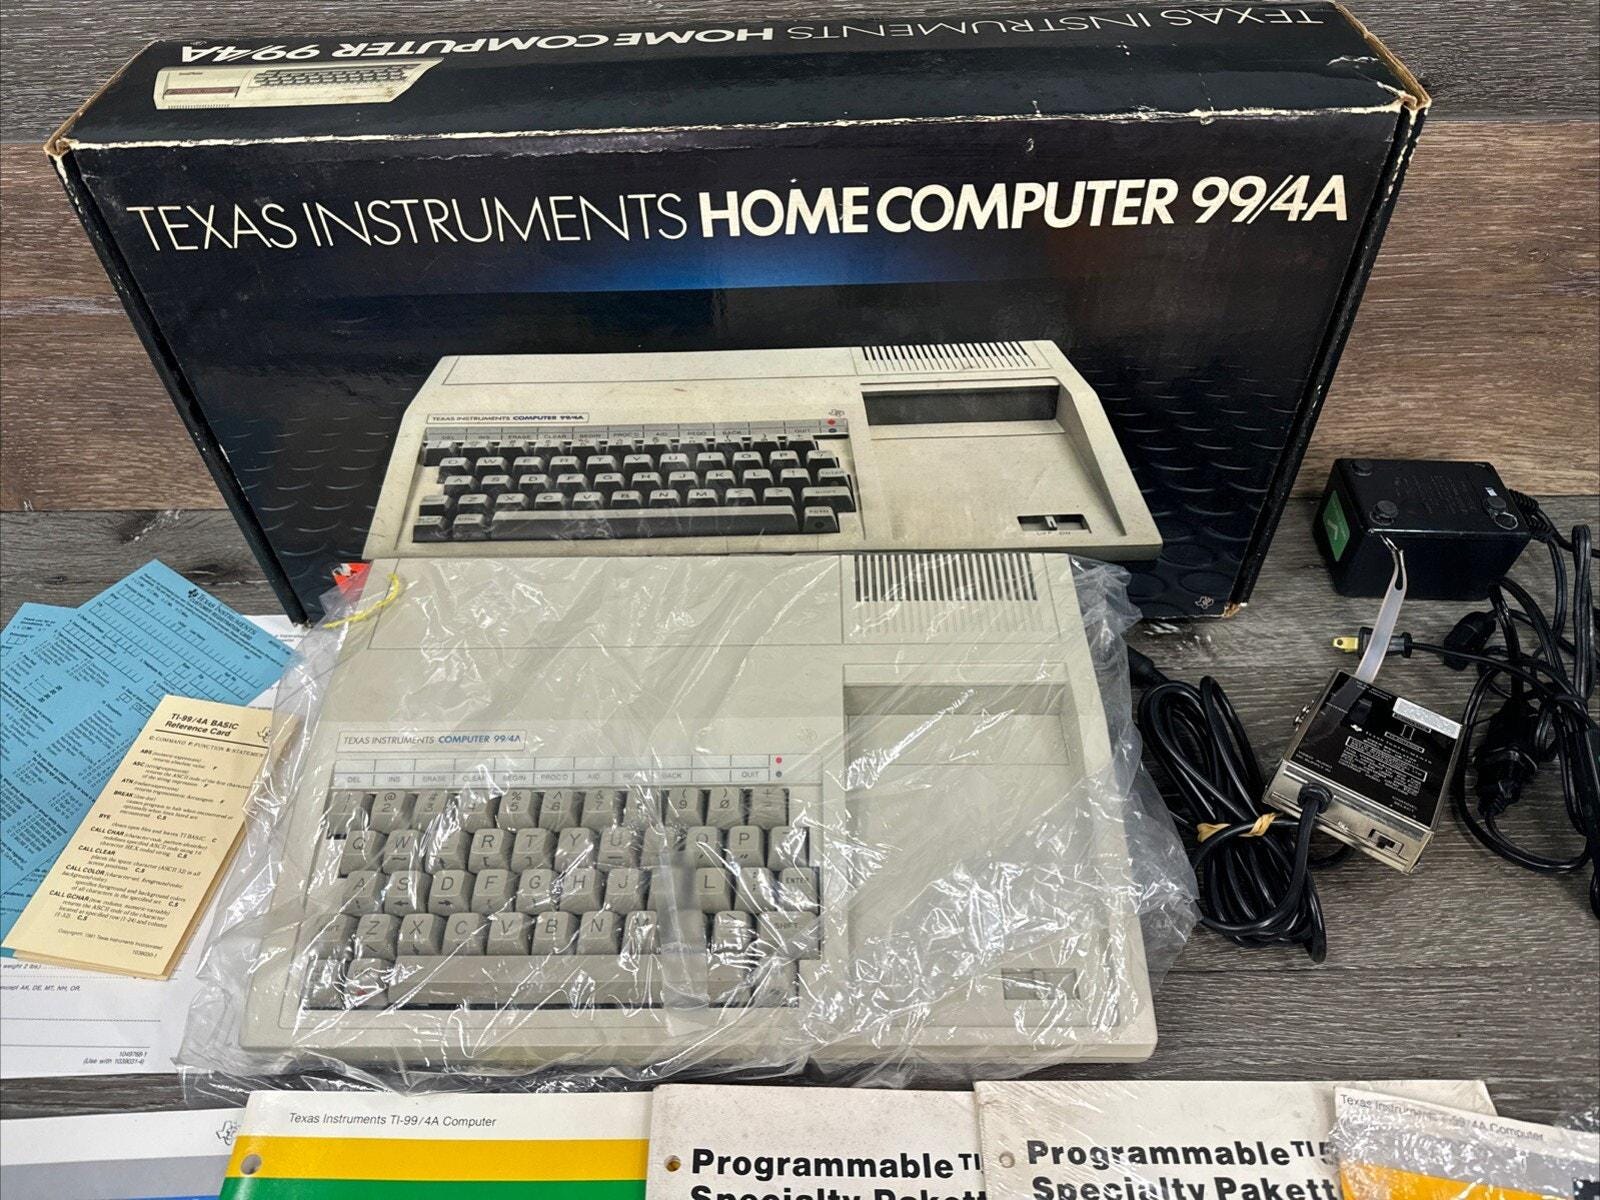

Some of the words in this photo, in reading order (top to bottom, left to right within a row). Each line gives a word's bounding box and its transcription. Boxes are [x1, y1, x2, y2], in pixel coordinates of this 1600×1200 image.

[789, 12, 1150, 39] INSTRUMENTS
[1168, 8, 1324, 27] TEXAS
[332, 31, 609, 59] COMPUTER
[614, 27, 773, 47] HOME
[181, 45, 321, 63] 99/4A
[128, 204, 297, 251] TEXAS
[304, 193, 689, 247] INSTRUMENTS
[701, 187, 869, 239] HOME
[876, 179, 1181, 231] COMPUTER
[1191, 174, 1348, 224] 99/4A
[165, 720, 208, 733] Reference
[209, 728, 231, 737] Card
[171, 712, 208, 726] TI-99/4A
[210, 719, 240, 730] BASIC
[343, 736, 370, 744] TEXAS
[371, 735, 435, 744] INSTRUMENTS
[438, 735, 490, 744] COMPUTER
[493, 734, 522, 743] 99/4A
[347, 775, 361, 783] DEL
[388, 775, 401, 783] INS
[422, 775, 447, 783] ERASE
[741, 770, 760, 778] QUIT
[113, 790, 133, 798] BREAK
[90, 826, 106, 834] CALL
[107, 828, 125, 836] CHAR
[394, 835, 410, 847] W
[481, 834, 495, 848] R
[525, 834, 538, 847] T
[569, 833, 581, 847] Y
[610, 832, 622, 847] U
[739, 832, 750, 845] P
[94, 848, 115, 856] CLEAR
[82, 867, 105, 876] COLOR
[397, 876, 409, 890] S
[441, 876, 454, 890] D
[484, 875, 498, 890] F
[529, 875, 542, 890] G
[573, 875, 586, 889] H
[618, 875, 629, 889] J
[704, 875, 716, 889] L
[66, 893, 89, 901] GCHAR
[366, 920, 381, 935] Z
[409, 920, 425, 934] X
[455, 920, 469, 934] C
[500, 919, 514, 934] V
[545, 919, 559, 934] B
[590, 918, 604, 932] N
[289, 1112, 320, 1126] Texas
[322, 1112, 387, 1126] Instruments
[390, 1113, 440, 1128] TI-99/4A
[443, 1115, 497, 1130] Computer
[1340, 1093, 1372, 1108] Texas
[1489, 1122, 1544, 1141] Computer
[1026, 1139, 1290, 1171] Programmable
[1290, 1140, 1315, 1157] TI
[692, 1148, 954, 1182] Programmable
[958, 1153, 981, 1170] TI
[1032, 1176, 1205, 1200] Specialty
[1214, 1176, 1335, 1200] Pakett
